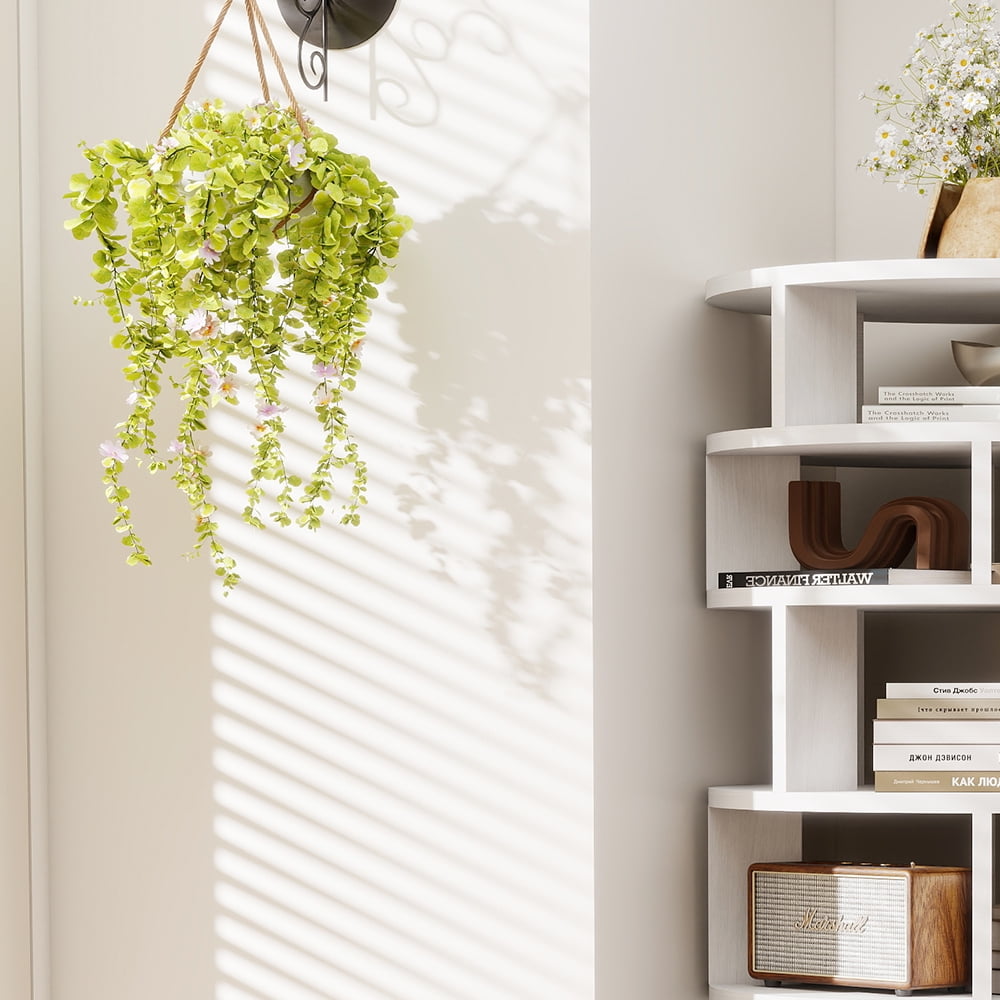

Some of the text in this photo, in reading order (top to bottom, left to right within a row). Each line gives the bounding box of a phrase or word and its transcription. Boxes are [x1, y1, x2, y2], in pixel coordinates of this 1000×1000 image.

[952, 686, 978, 695] Джобс
[908, 754, 972, 762] ДЖОН ДЭВИСОН
[951, 777, 975, 787] КАК
[794, 908, 870, 934] Marshall
